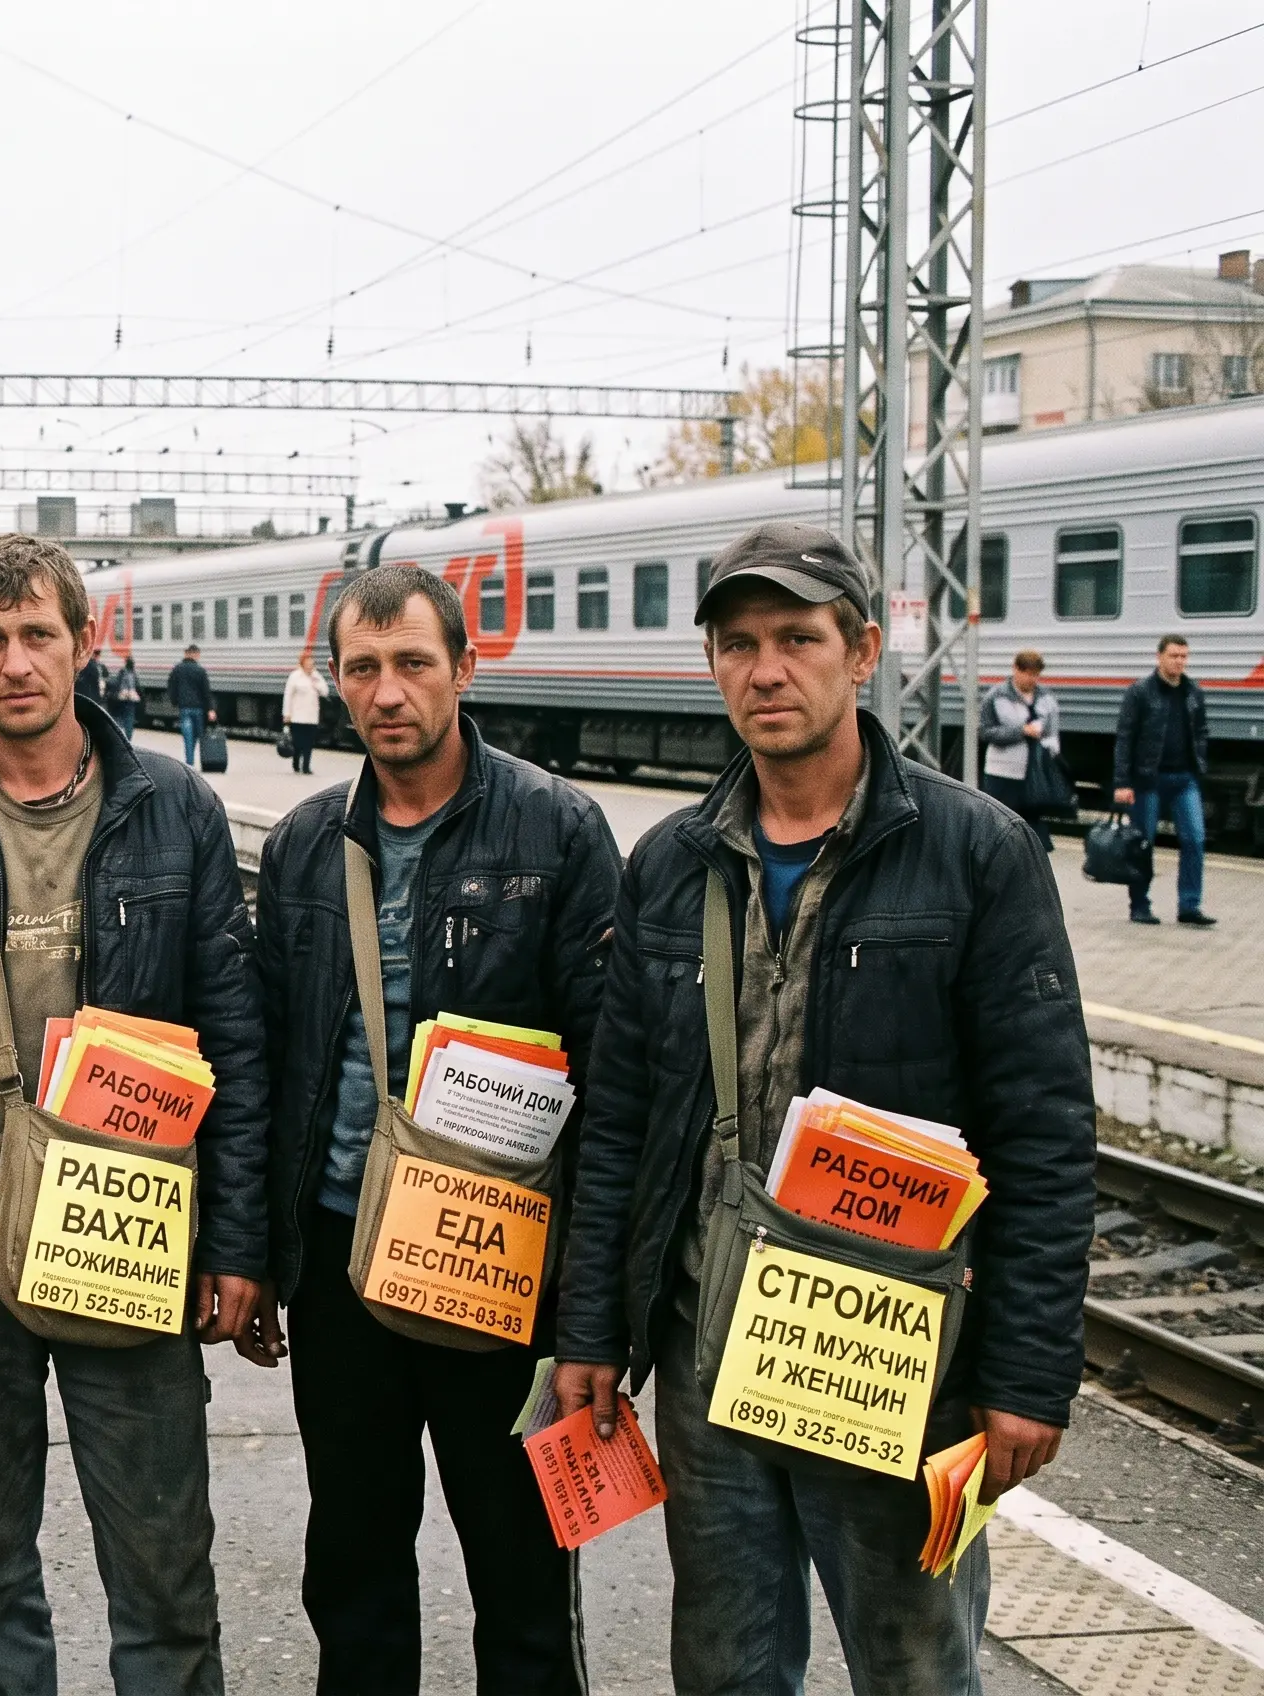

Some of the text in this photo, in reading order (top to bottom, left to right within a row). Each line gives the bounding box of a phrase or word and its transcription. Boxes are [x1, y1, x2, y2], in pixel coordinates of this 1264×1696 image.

[87, 1063, 194, 1122] РАБОЧИЙ
[443, 1067, 524, 1105] РАБОЧИЙ
[524, 1091, 563, 1116] ДОМ
[102, 1104, 158, 1141] ДОМ
[56, 1156, 183, 1213] РАБОТА
[402, 1166, 548, 1224] ПРОЖИВАНИЕ
[810, 1146, 950, 1209] РАБОЧИЙ
[61, 1202, 169, 1254] ВАХТА
[435, 1207, 506, 1255] ЕДА
[831, 1189, 902, 1228] ДОМ
[34, 1241, 181, 1289] ПРОЖИВАНИЕ
[387, 1238, 534, 1298] БЕСПЛАТНО
[30, 1281, 79, 1311] (987)
[85, 1293, 173, 1326] 525-05-12
[379, 1279, 427, 1313] (997)
[757, 1263, 932, 1342] СТРОЙКА
[745, 1313, 928, 1384] ДЛЯ МУЖЧИН
[755, 1353, 776, 1380] И
[781, 1360, 907, 1415] ЖЕНЩИН
[729, 1398, 786, 1436] (899)
[793, 1417, 904, 1464] 325-05-32
